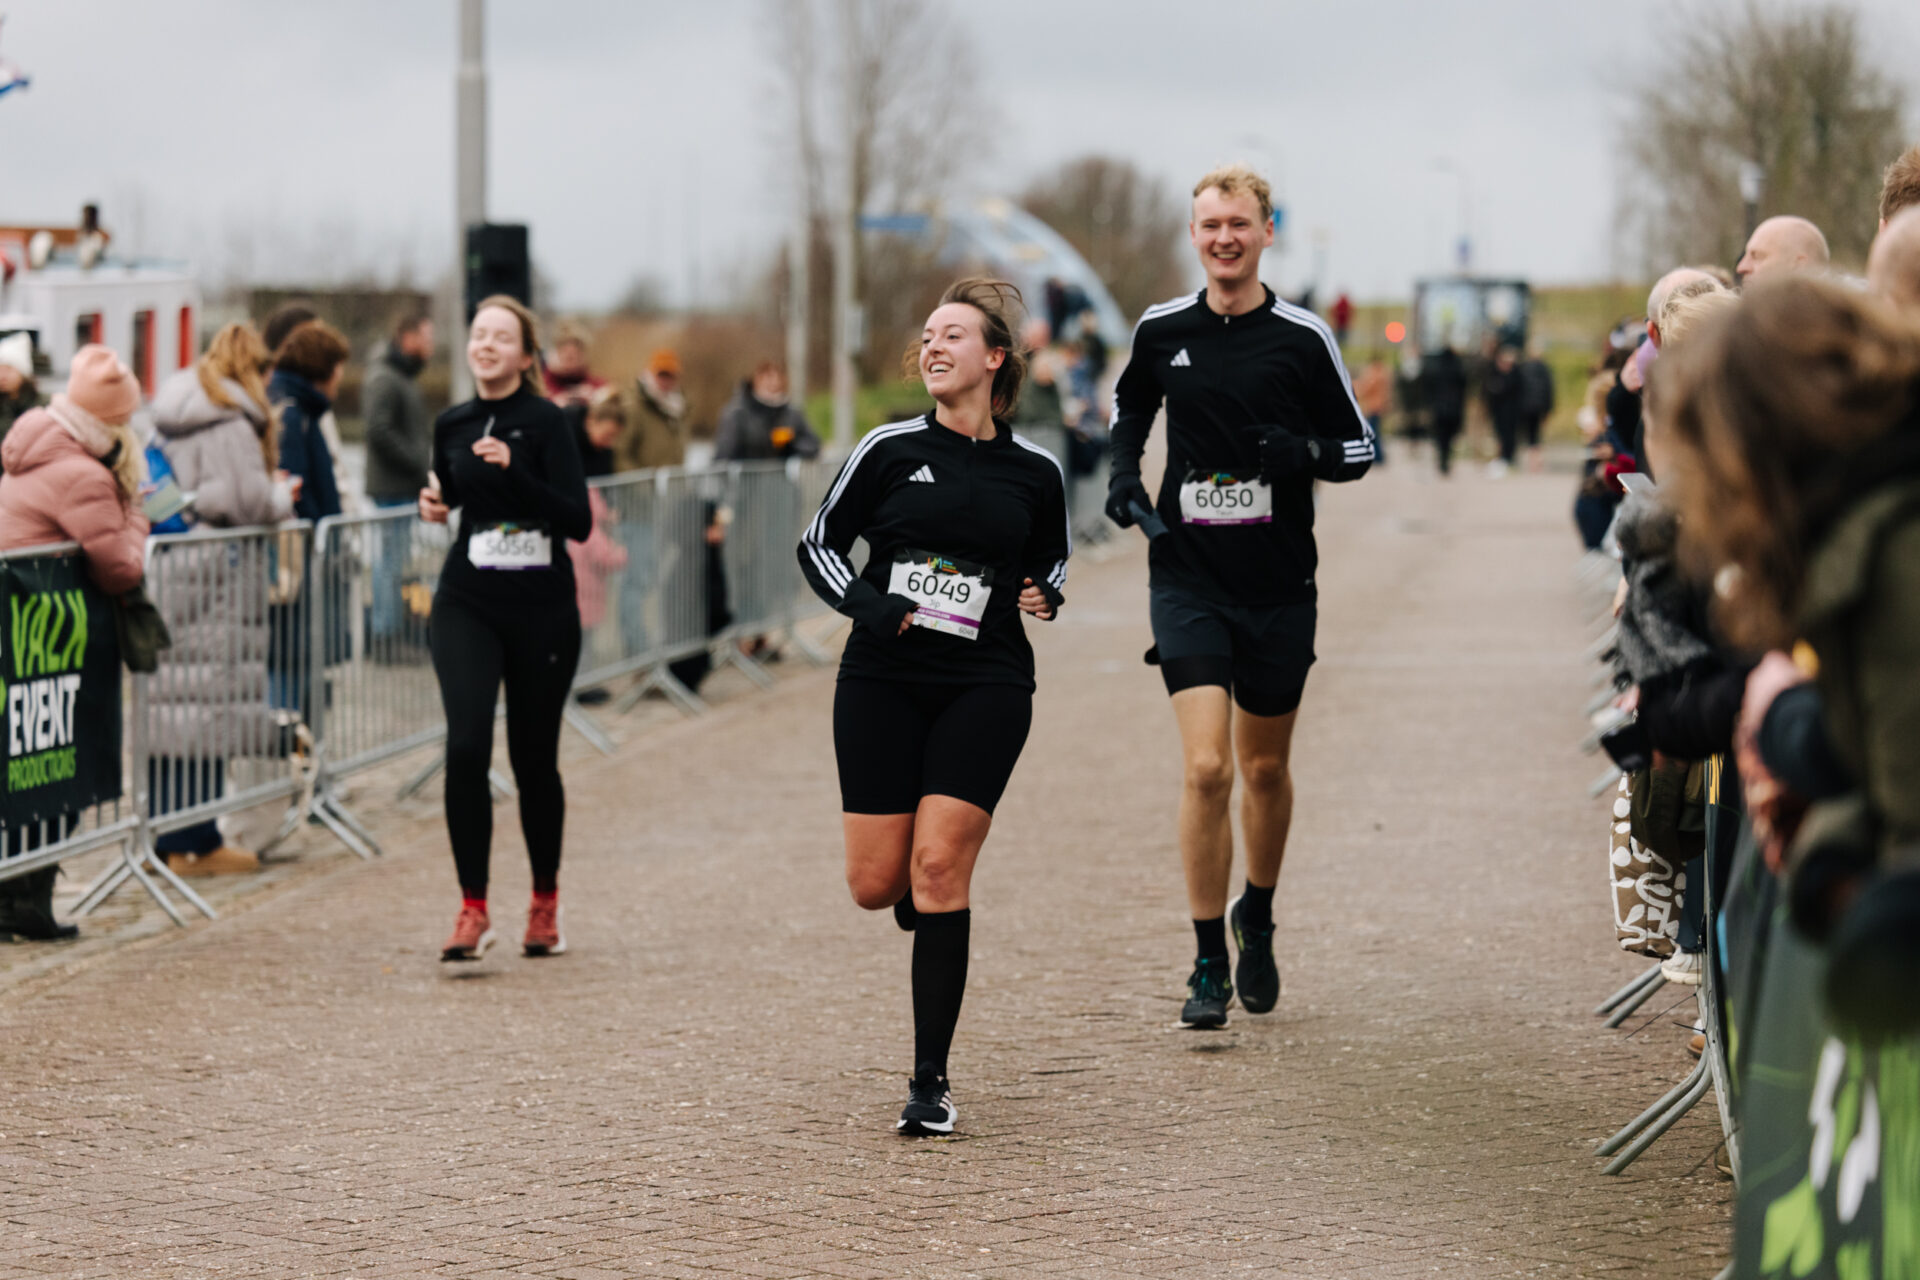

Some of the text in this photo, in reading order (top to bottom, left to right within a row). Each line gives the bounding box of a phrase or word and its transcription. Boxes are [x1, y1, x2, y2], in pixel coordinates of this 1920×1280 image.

[1195, 488, 1254, 508] 6050
[907, 571, 971, 604] 6049
[9, 673, 81, 757] EVENT
[8, 746, 77, 794] PRODUCTIONS
